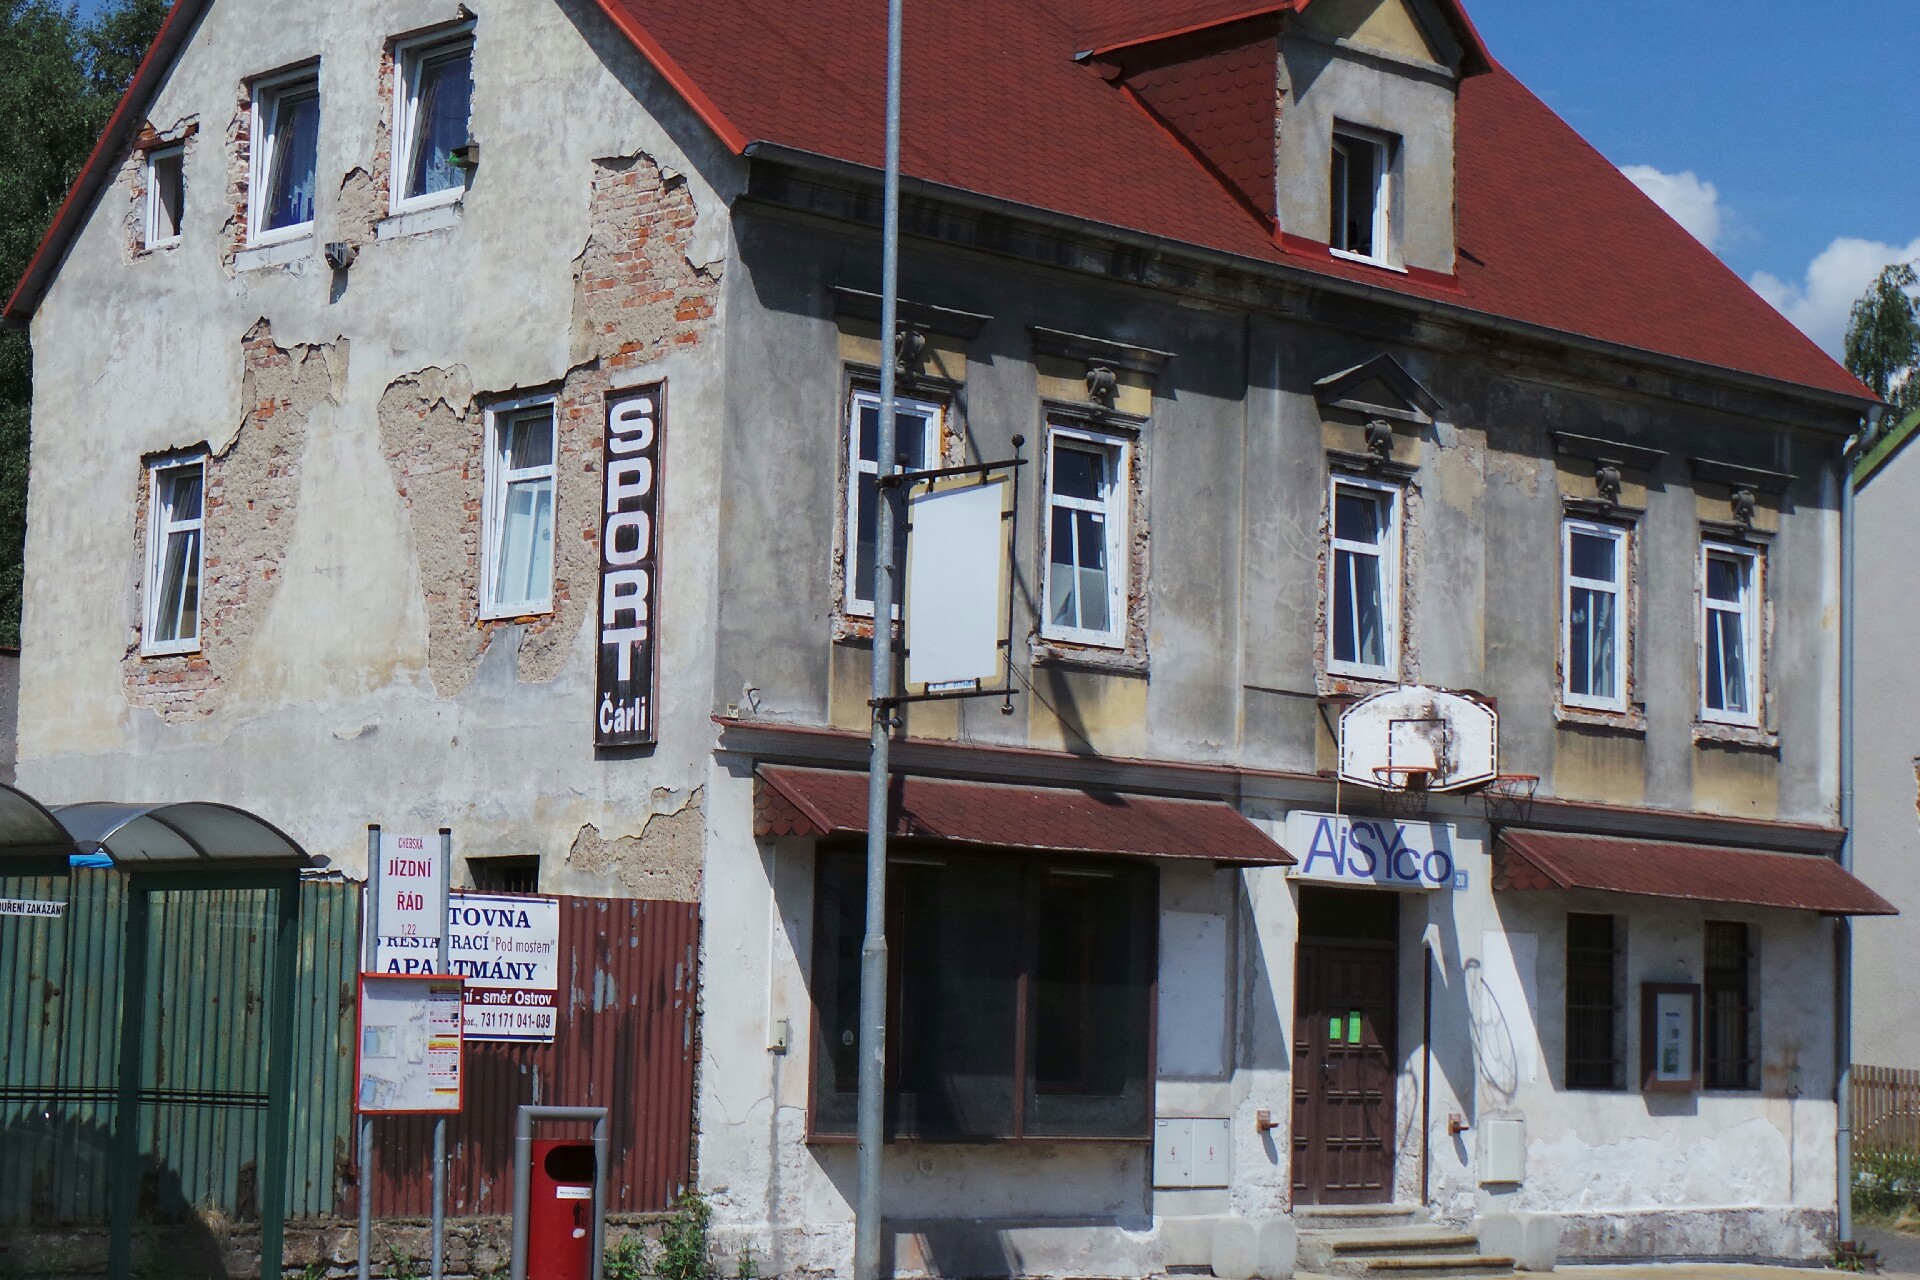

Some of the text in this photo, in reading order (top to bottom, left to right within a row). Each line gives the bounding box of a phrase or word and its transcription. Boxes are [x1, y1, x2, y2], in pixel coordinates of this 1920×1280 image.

[602, 398, 654, 681] SPORT
[600, 692, 646, 734] Čárli
[398, 836, 424, 850] CHEBSKÁ
[388, 856, 432, 878] JÍZDNÍ
[0, 900, 25, 913] UŘENÍ
[397, 890, 424, 911] ŘÁD
[449, 907, 531, 929] TOVNA
[482, 989, 513, 1005] směr
[514, 990, 552, 1006] Ostrov
